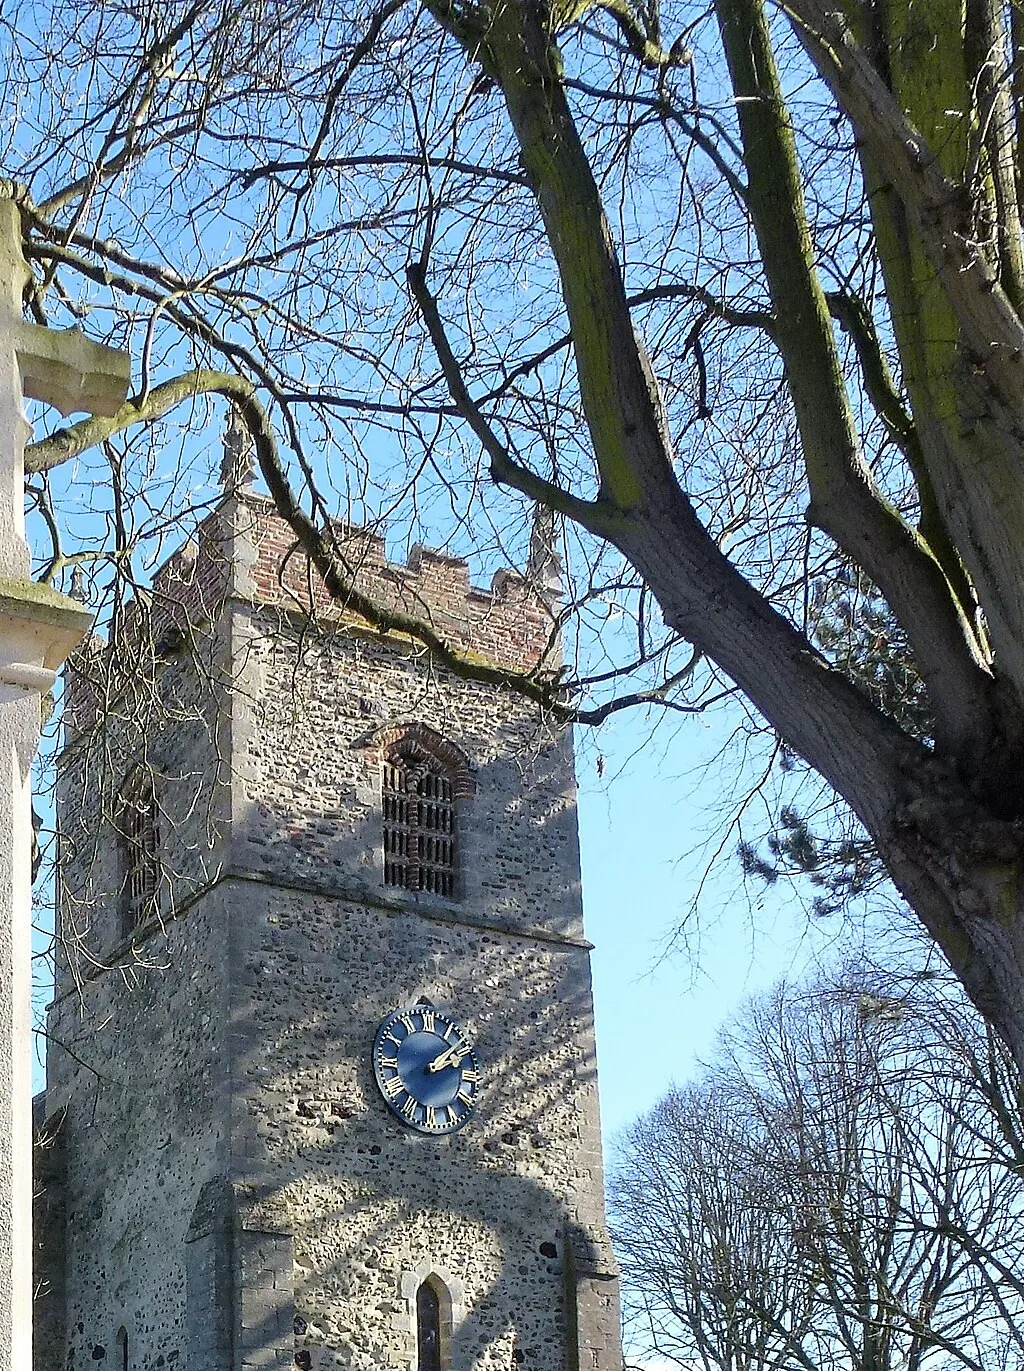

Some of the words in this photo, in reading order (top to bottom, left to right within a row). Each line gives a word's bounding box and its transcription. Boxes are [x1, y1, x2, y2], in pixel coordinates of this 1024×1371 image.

[400, 1015, 417, 1036] XI
[421, 1013, 436, 1033] XII
[442, 1022, 455, 1041] I
[385, 1030, 403, 1048] X
[381, 1056, 398, 1068] IX
[461, 1069, 478, 1082] III
[385, 1075, 406, 1099] VIII
[400, 1095, 418, 1119] VII
[425, 1105, 437, 1126] VI
